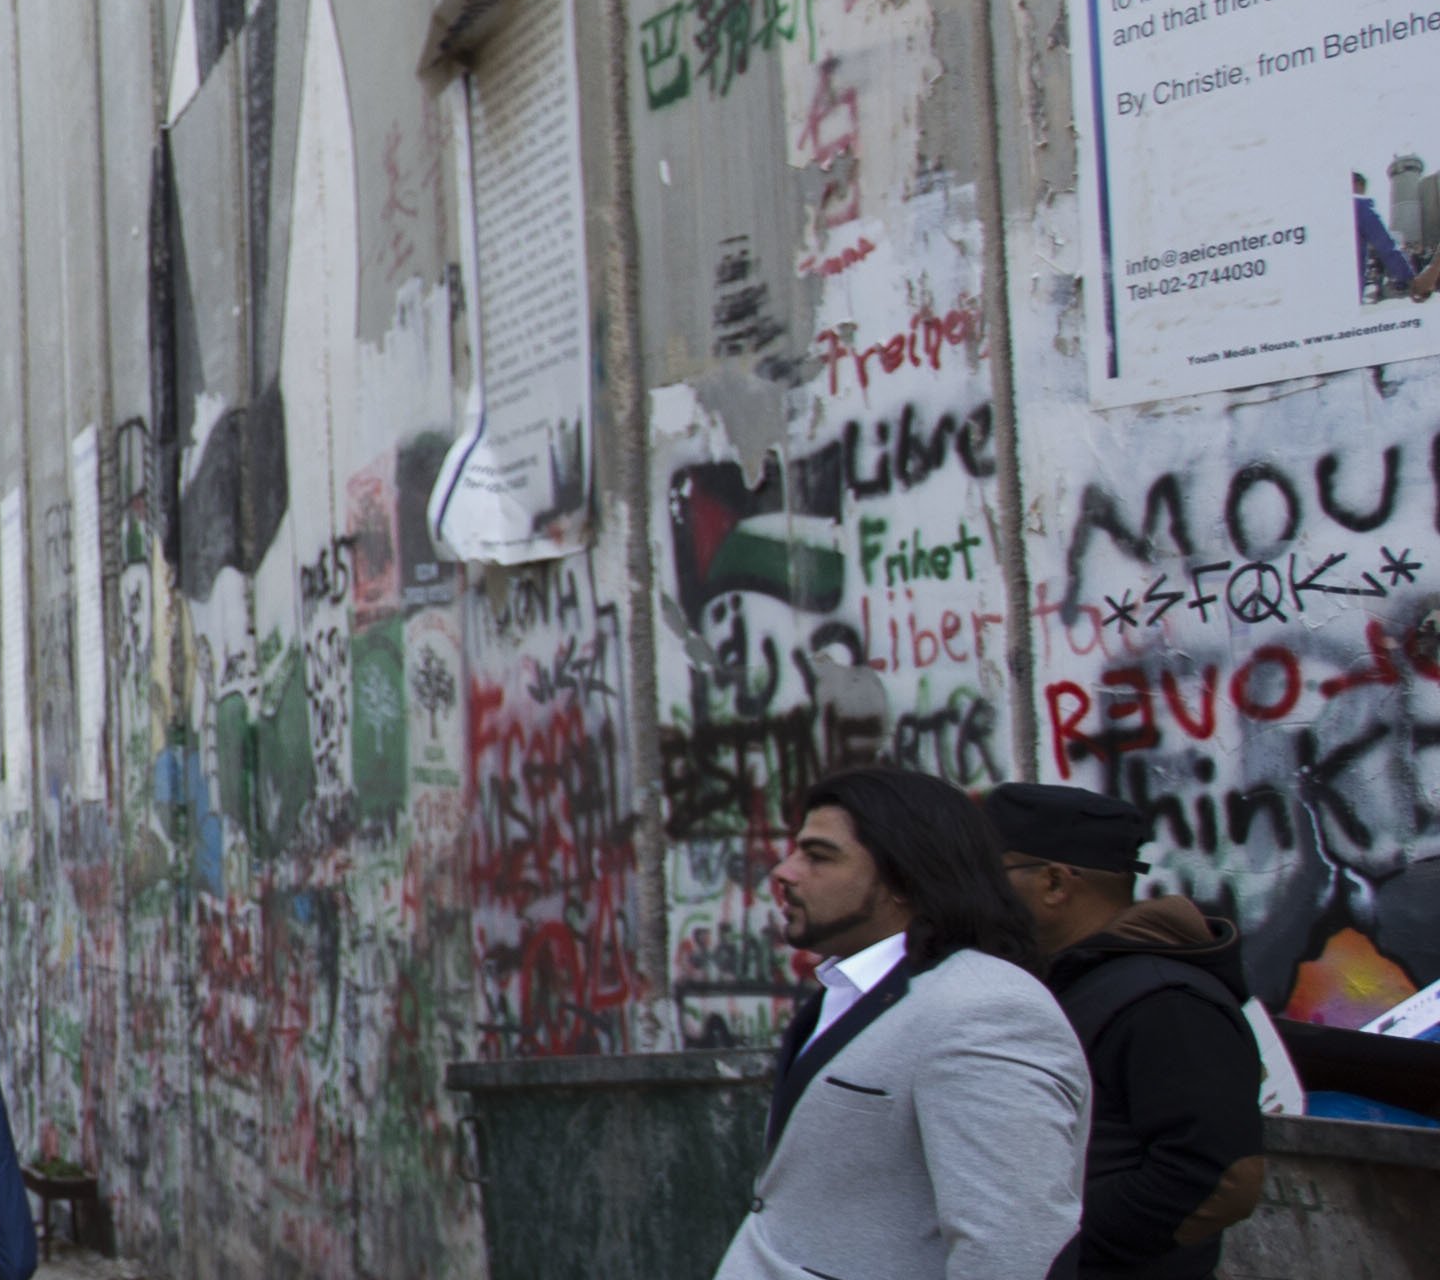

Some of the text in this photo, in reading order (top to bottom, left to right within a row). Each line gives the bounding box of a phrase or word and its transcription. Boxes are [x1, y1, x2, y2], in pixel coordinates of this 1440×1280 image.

[1113, 14, 1154, 46] and
[1162, 0, 1207, 31] that
[1116, 91, 1146, 117] By
[1153, 65, 1251, 105] Christie,
[1257, 45, 1315, 77] from
[1125, 225, 1307, 276] info@aeicenter.org
[1126, 258, 1266, 301] Tel-02-2744030
[1187, 351, 1220, 365] Youth
[840, 401, 999, 497] Libre
[859, 518, 983, 588] Frihet
[1060, 432, 1440, 627] MOU
